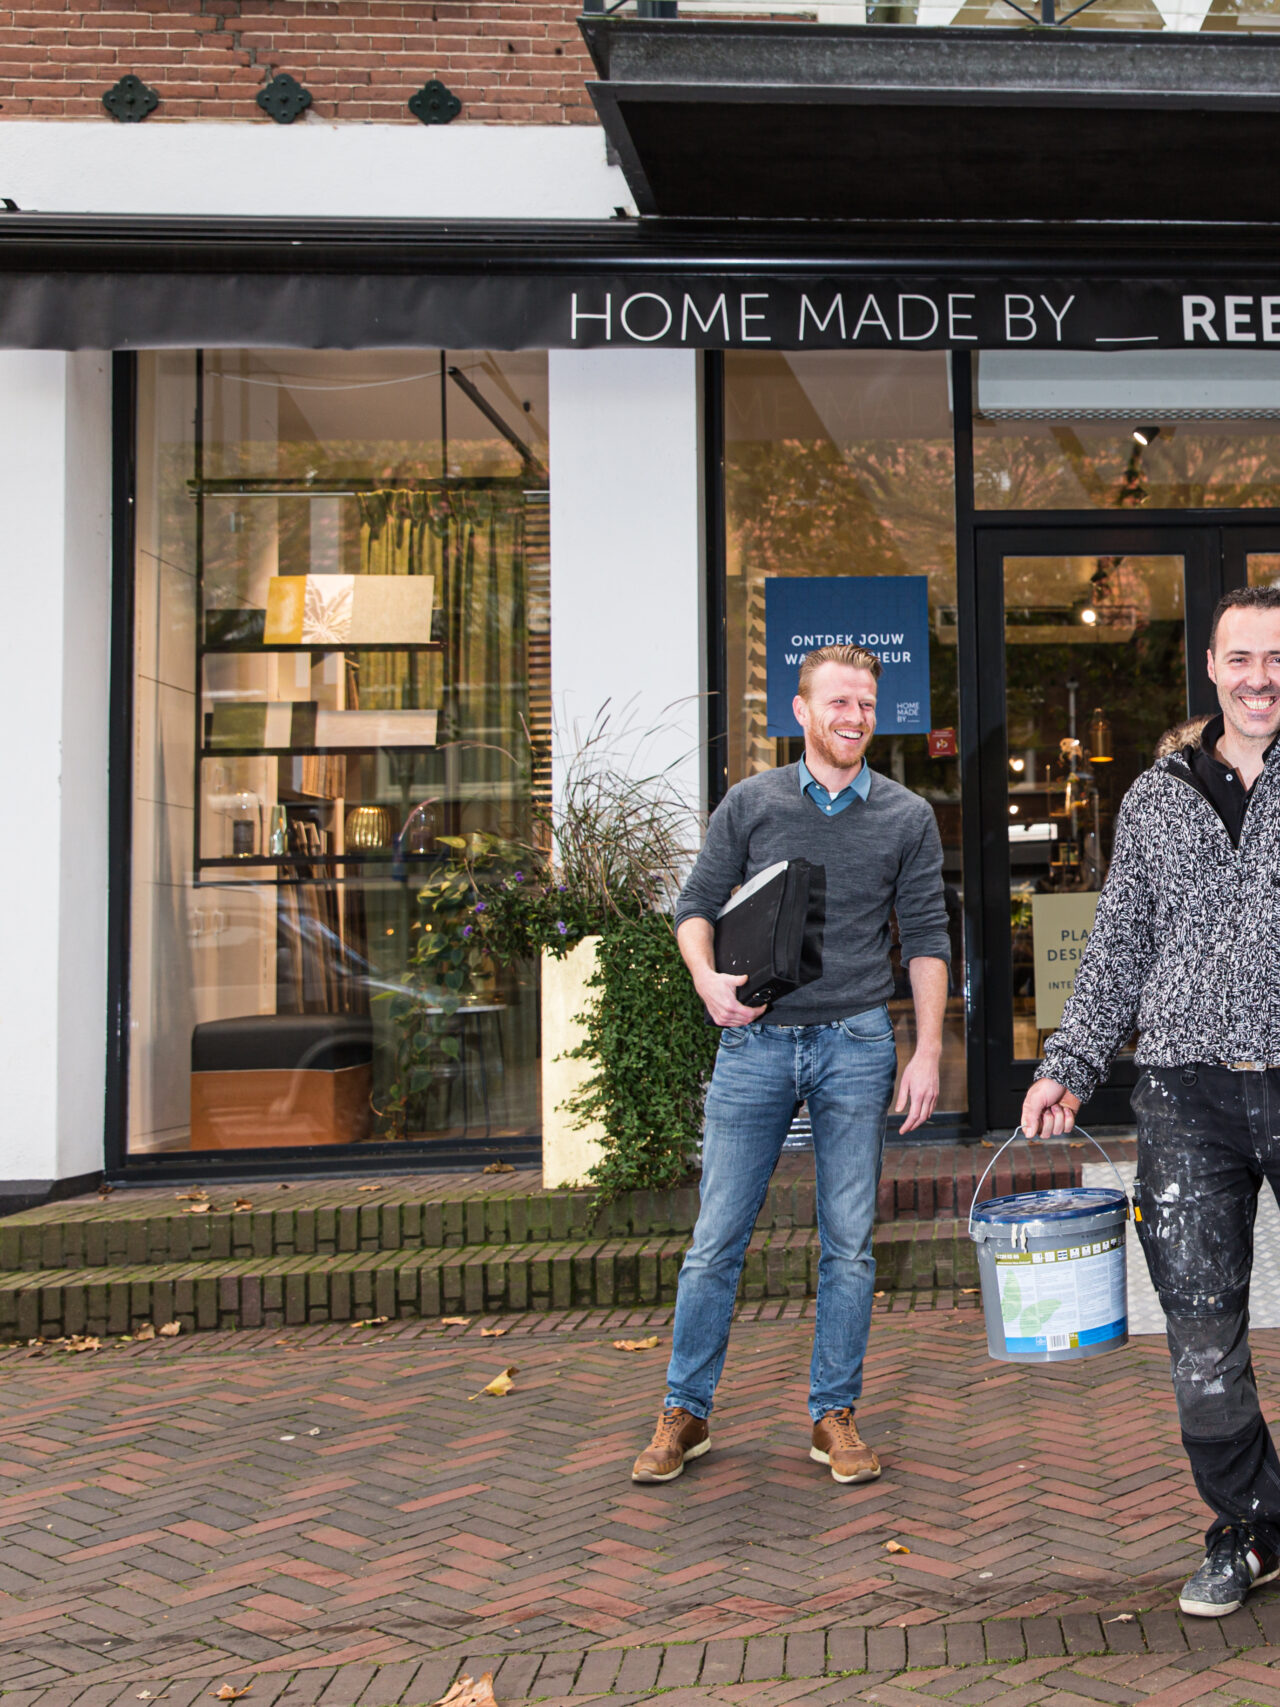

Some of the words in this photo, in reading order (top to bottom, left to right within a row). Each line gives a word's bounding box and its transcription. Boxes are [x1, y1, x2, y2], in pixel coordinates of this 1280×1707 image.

[570, 292, 771, 341] HOME
[799, 293, 977, 341] MADE
[1005, 294, 1075, 341] BY
[791, 634, 854, 646] ONTDEK
[859, 633, 904, 645] JOUW
